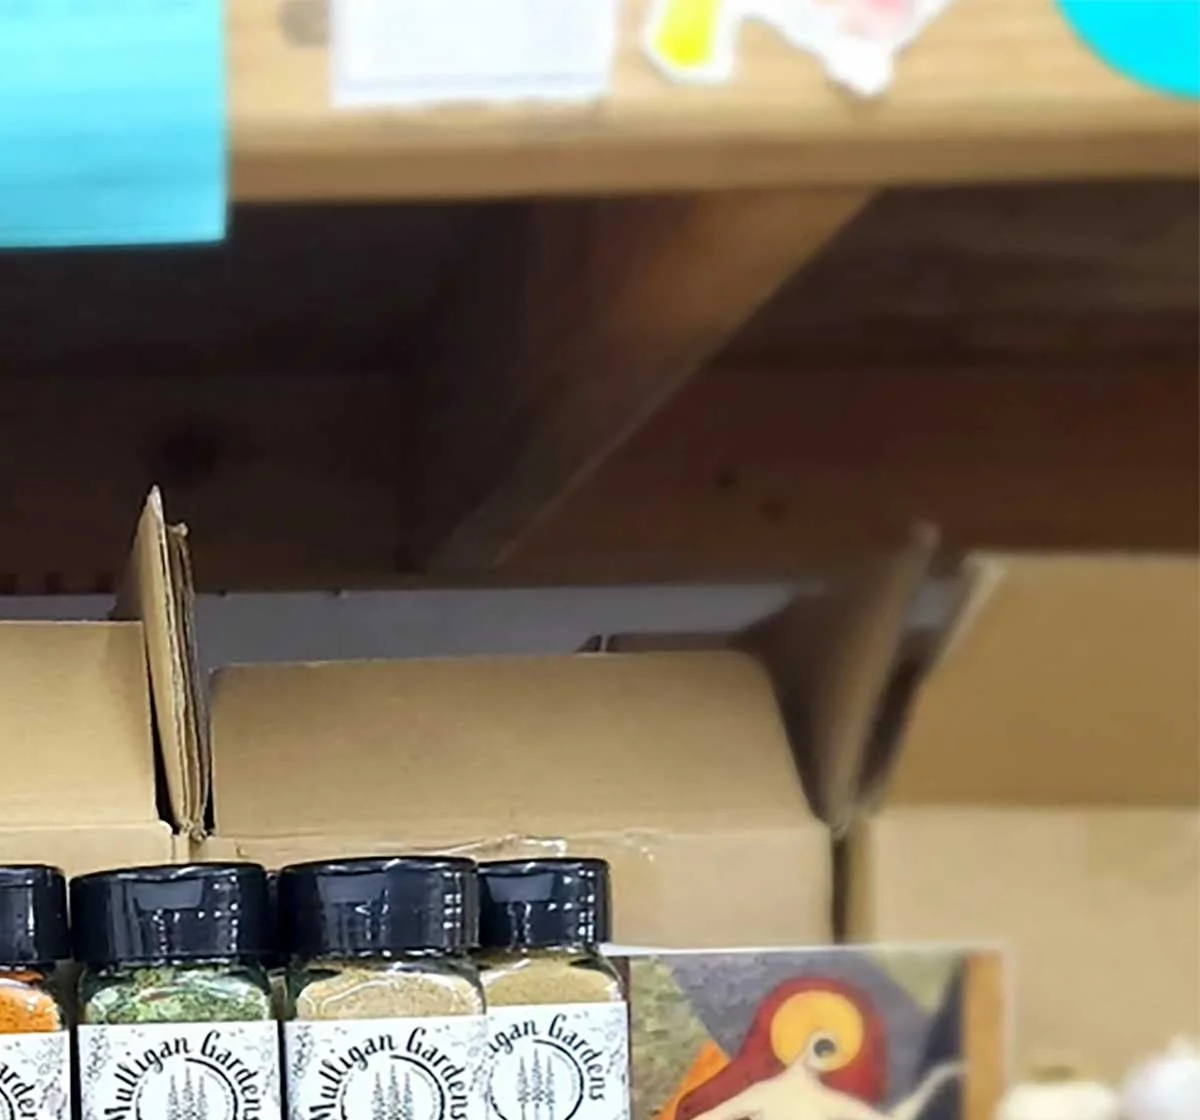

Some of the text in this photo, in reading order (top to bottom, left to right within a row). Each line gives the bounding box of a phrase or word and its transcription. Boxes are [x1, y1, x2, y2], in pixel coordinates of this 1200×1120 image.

[406, 1026, 468, 1120] Gardens
[488, 1013, 608, 1101] igan Gardens
